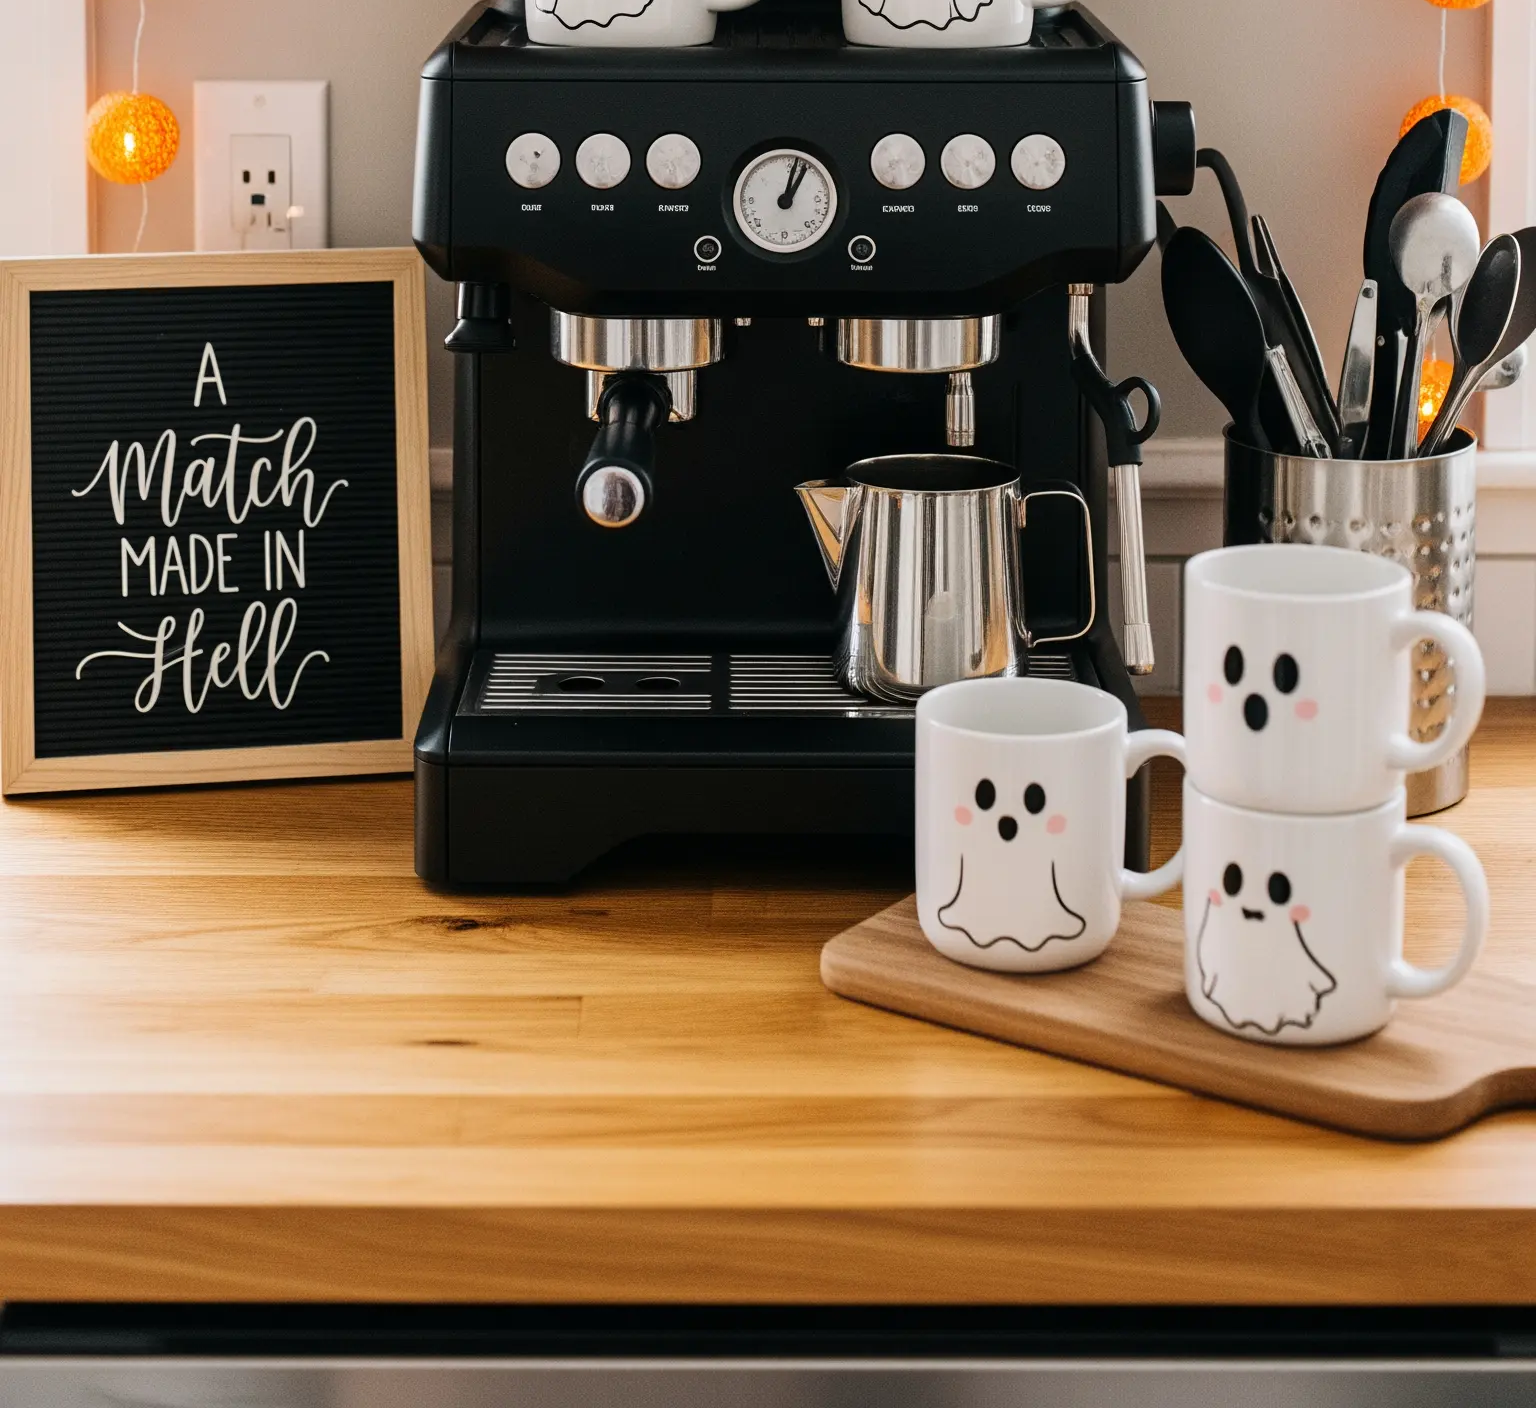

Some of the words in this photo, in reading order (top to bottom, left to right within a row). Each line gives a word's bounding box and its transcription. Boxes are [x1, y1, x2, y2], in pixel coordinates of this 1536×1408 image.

[193, 341, 227, 407] A
[71, 416, 349, 527] Match
[120, 533, 239, 597] MADE
[264, 529, 306, 591] IN
[75, 597, 330, 714] Hell
